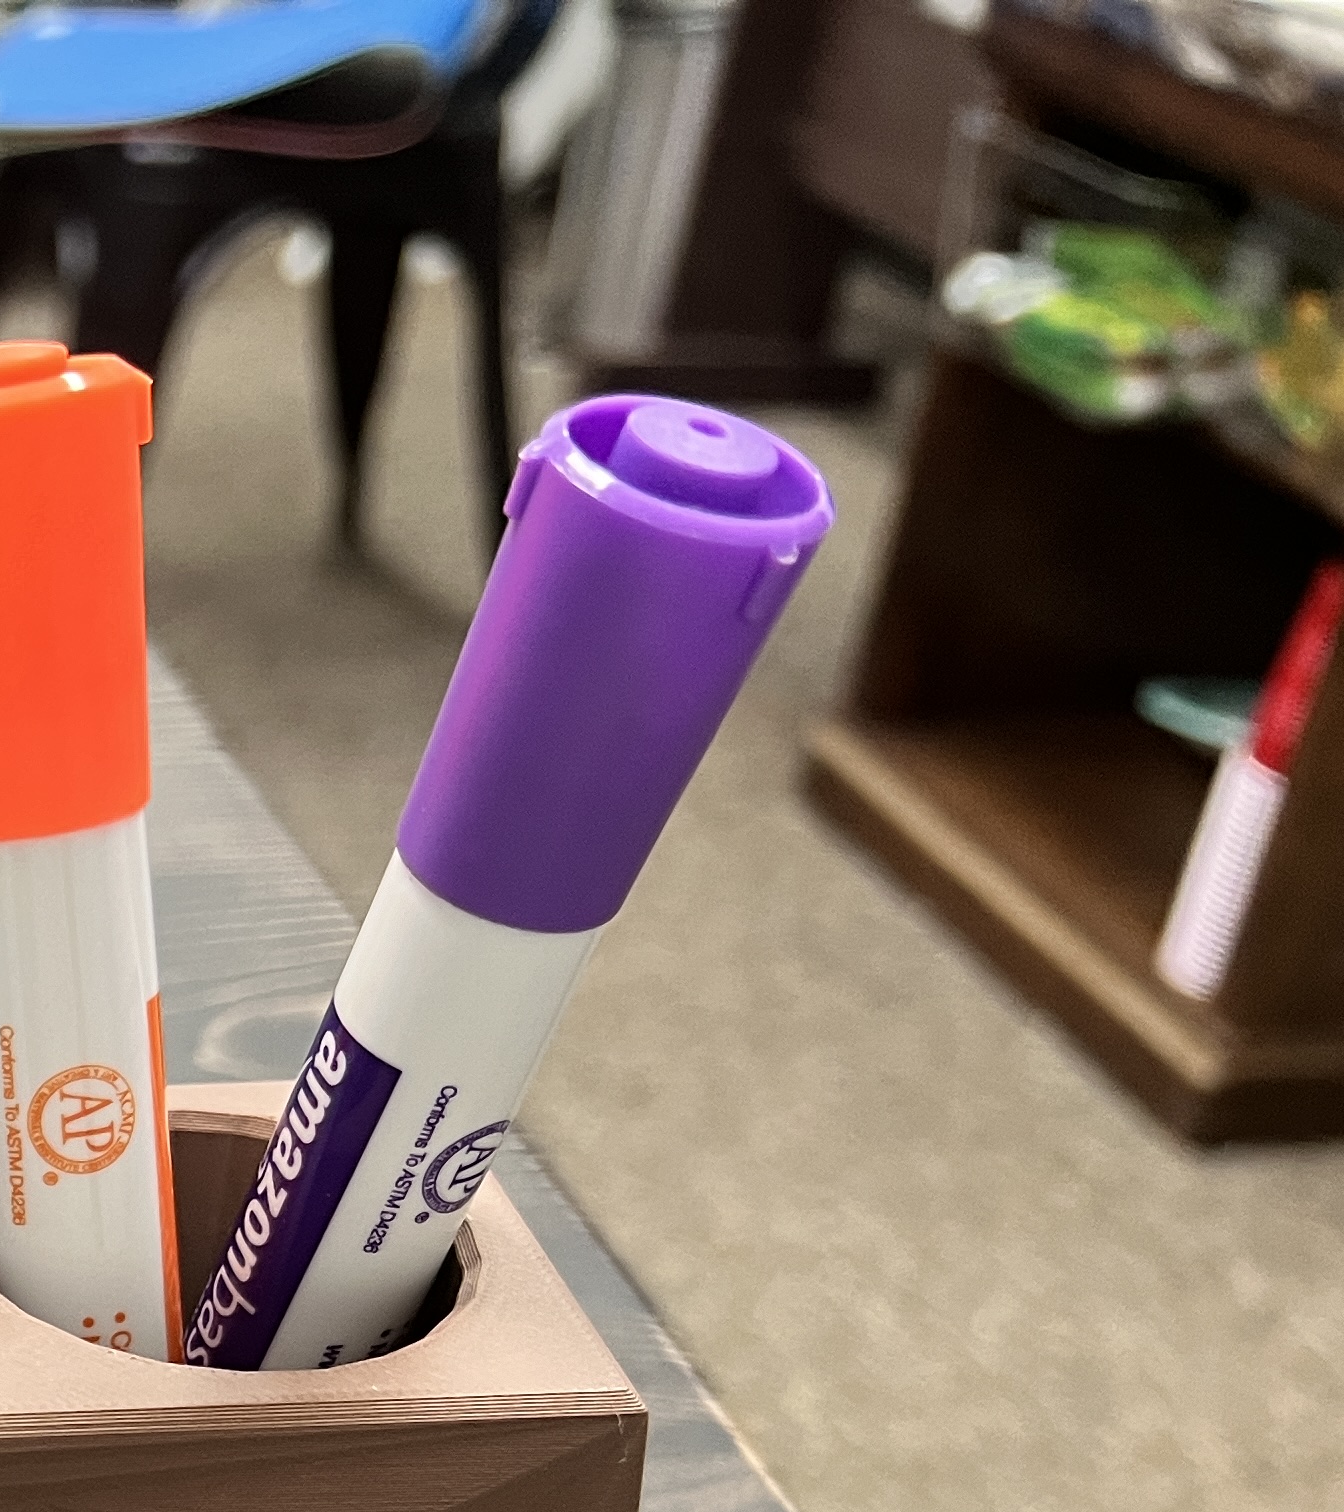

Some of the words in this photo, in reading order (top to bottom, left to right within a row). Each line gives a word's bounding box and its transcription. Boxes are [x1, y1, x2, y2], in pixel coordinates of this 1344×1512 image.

[4, 1103, 20, 1122] To
[59, 1088, 116, 1153] AP
[414, 1085, 457, 1148] Conforms
[6, 1125, 24, 1171] ASTM
[405, 1152, 427, 1168] To
[384, 1168, 416, 1209] ASTM
[363, 1209, 397, 1254] D4236
